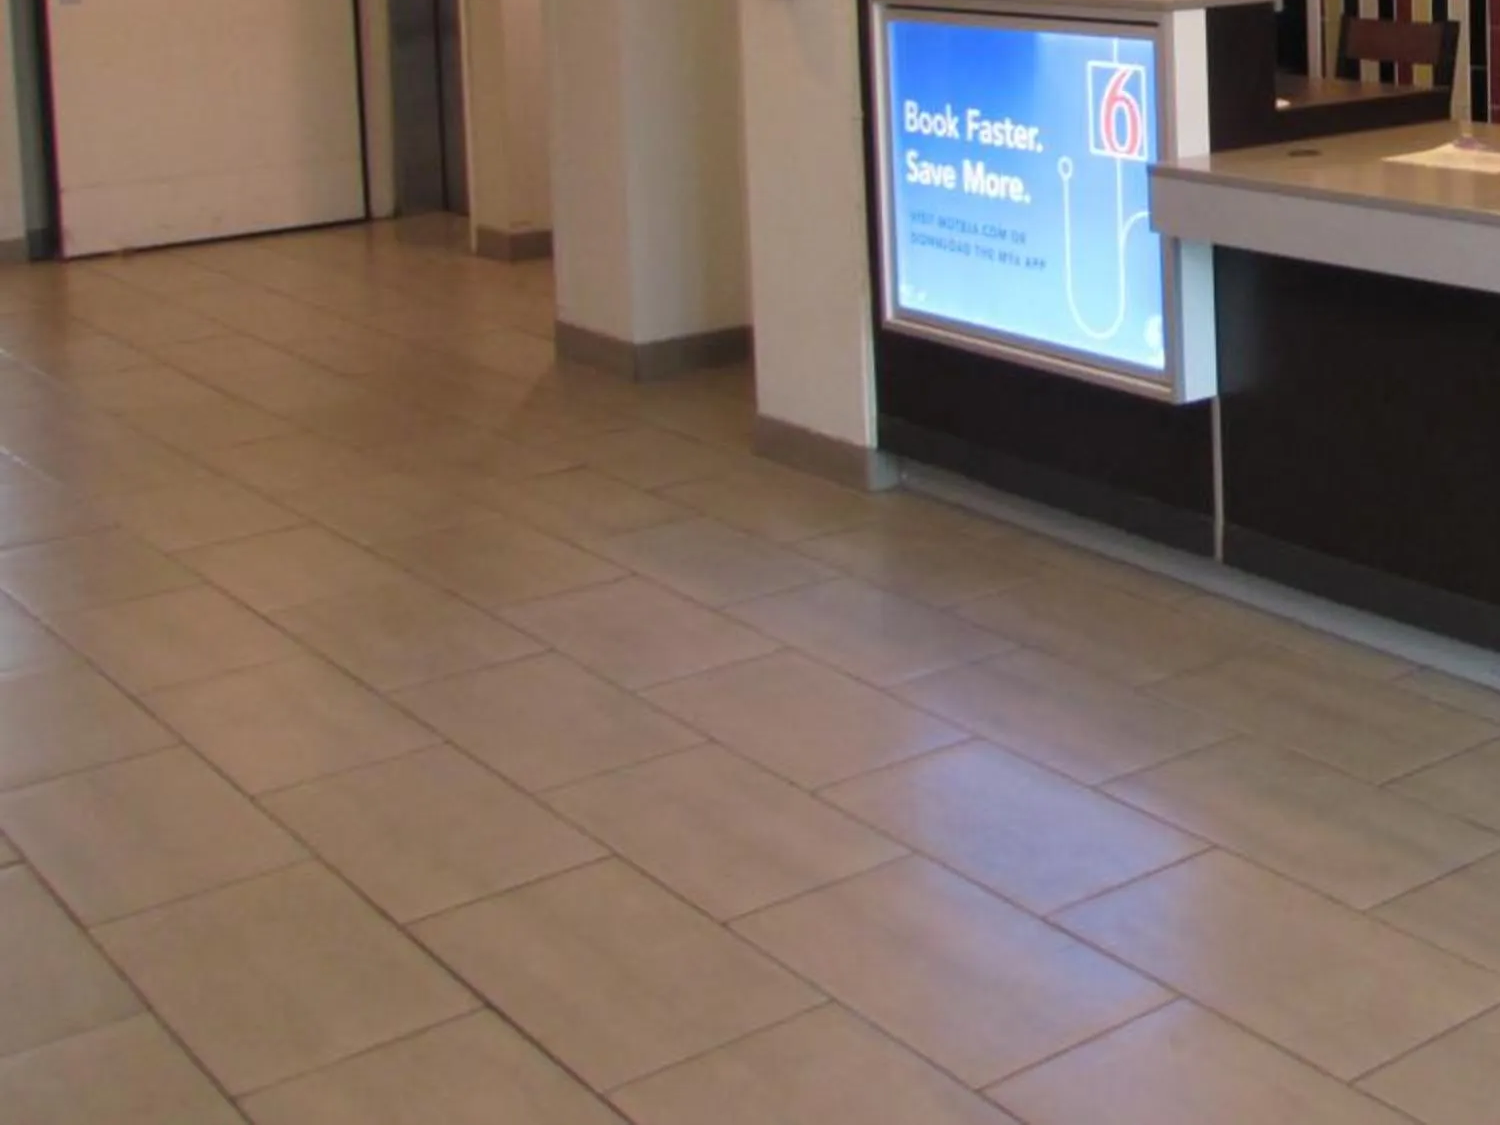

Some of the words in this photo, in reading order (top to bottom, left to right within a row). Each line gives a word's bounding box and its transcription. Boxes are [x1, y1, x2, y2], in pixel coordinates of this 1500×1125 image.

[905, 99, 960, 139] Book
[966, 107, 1044, 153] Faster.
[1100, 67, 1142, 157] 6
[905, 149, 957, 190] Save
[962, 158, 1032, 204] More.
